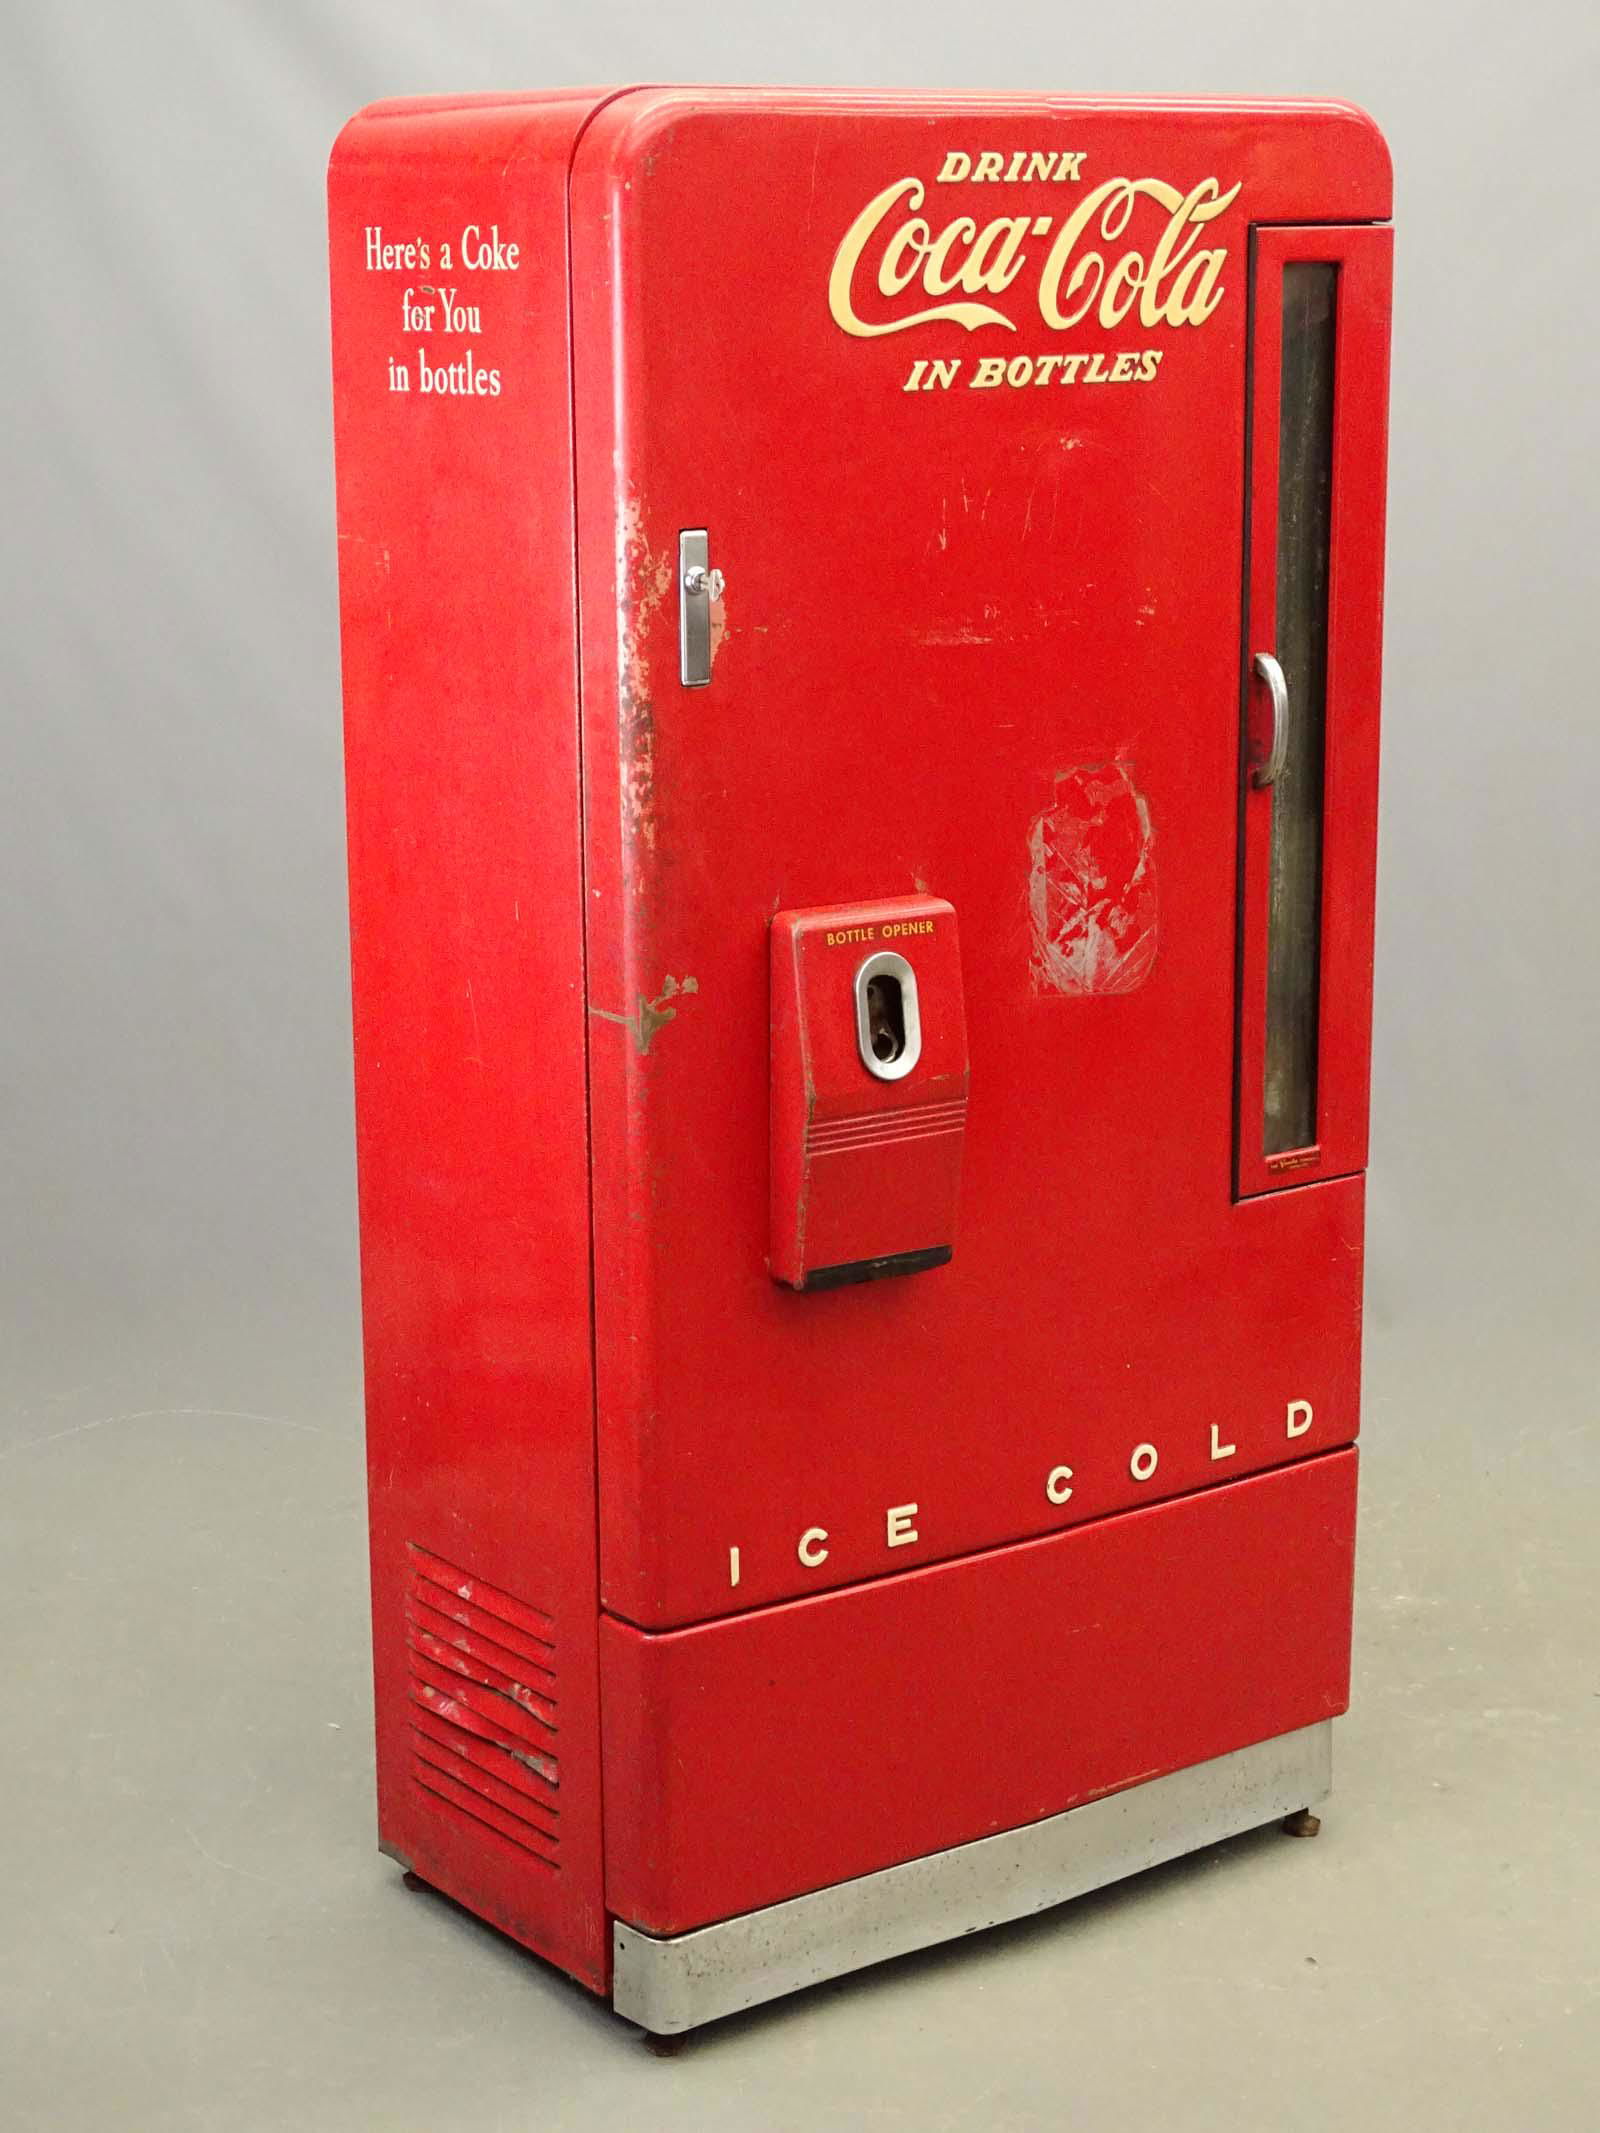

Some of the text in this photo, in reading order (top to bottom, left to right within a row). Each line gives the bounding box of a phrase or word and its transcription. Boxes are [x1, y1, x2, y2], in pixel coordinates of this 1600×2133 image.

[937, 152, 1087, 183] DRINK
[365, 224, 520, 270] Here's a Coke
[828, 176, 1243, 337] Coca-Cola
[402, 288, 482, 333] for You
[388, 347, 502, 396] in bottles
[903, 350, 1164, 392] IN BOTTLES
[826, 920, 934, 946] BOTTLE OPENER
[730, 1400, 1313, 1586] ICE COLD
